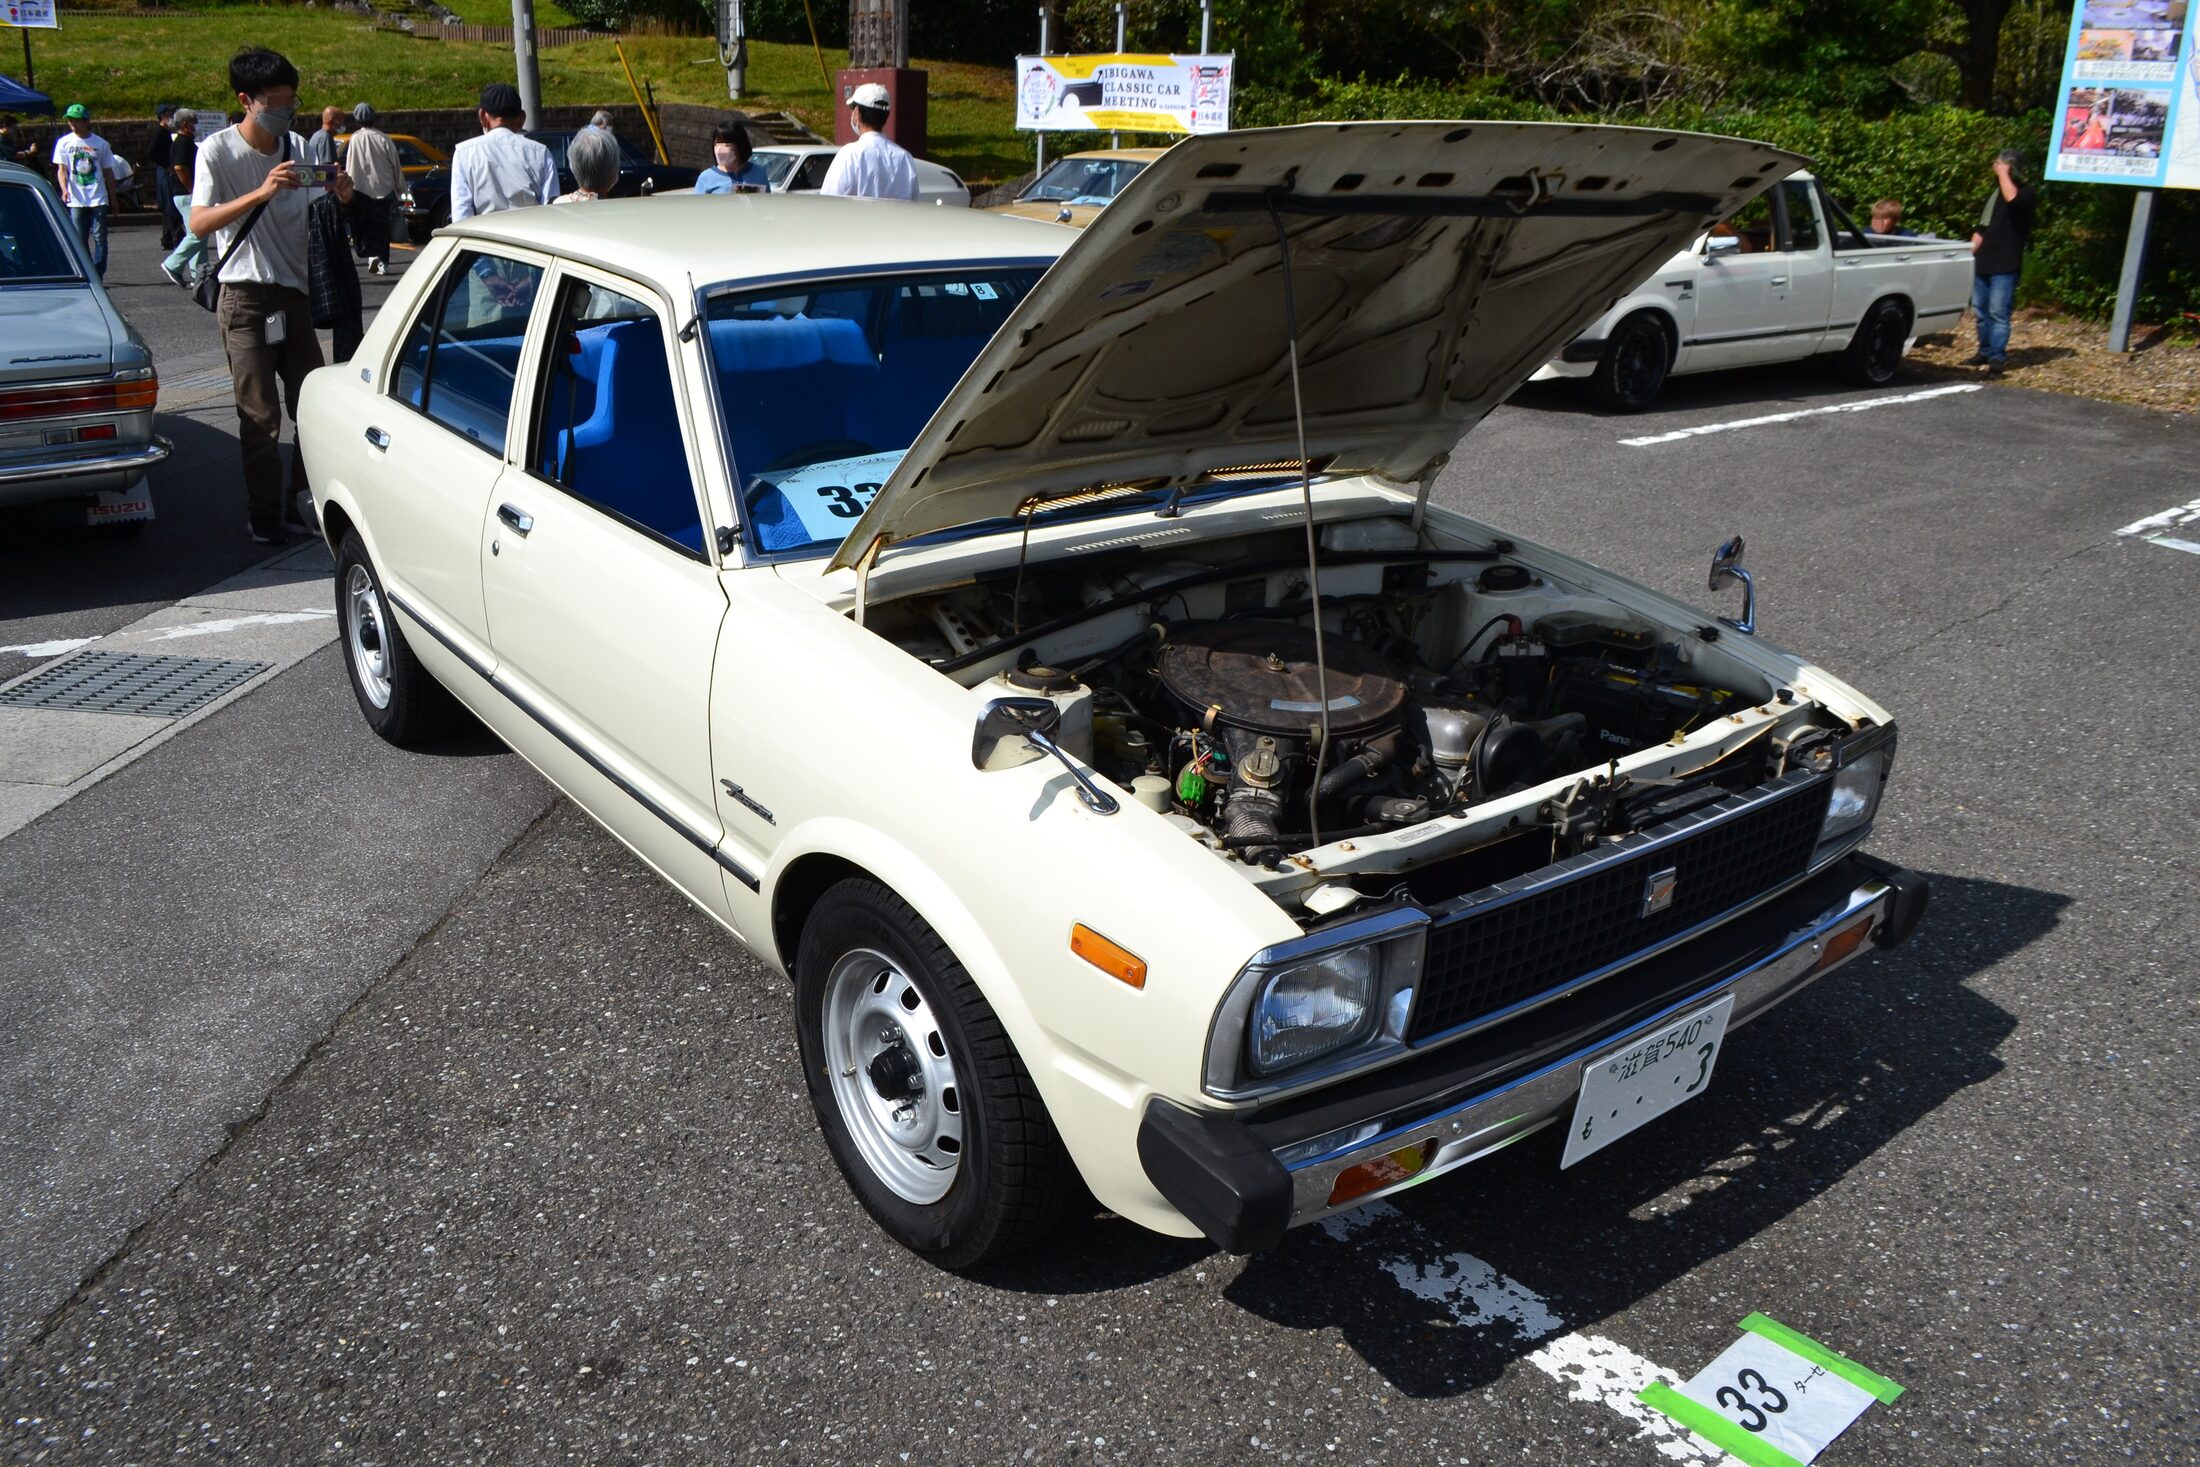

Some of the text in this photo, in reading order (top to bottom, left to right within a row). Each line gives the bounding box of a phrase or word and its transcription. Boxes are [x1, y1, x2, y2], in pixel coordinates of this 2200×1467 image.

[1104, 67, 1154, 79] IBIGAWA
[1104, 82, 1181, 96] CLASSIC CAR
[1104, 96, 1157, 109] MEETING
[975, 285, 985, 295] 8
[92, 502, 147, 516] ISUZU
[1794, 1365, 1829, 1395] ターセ
[1715, 1368, 1789, 1433] 33
